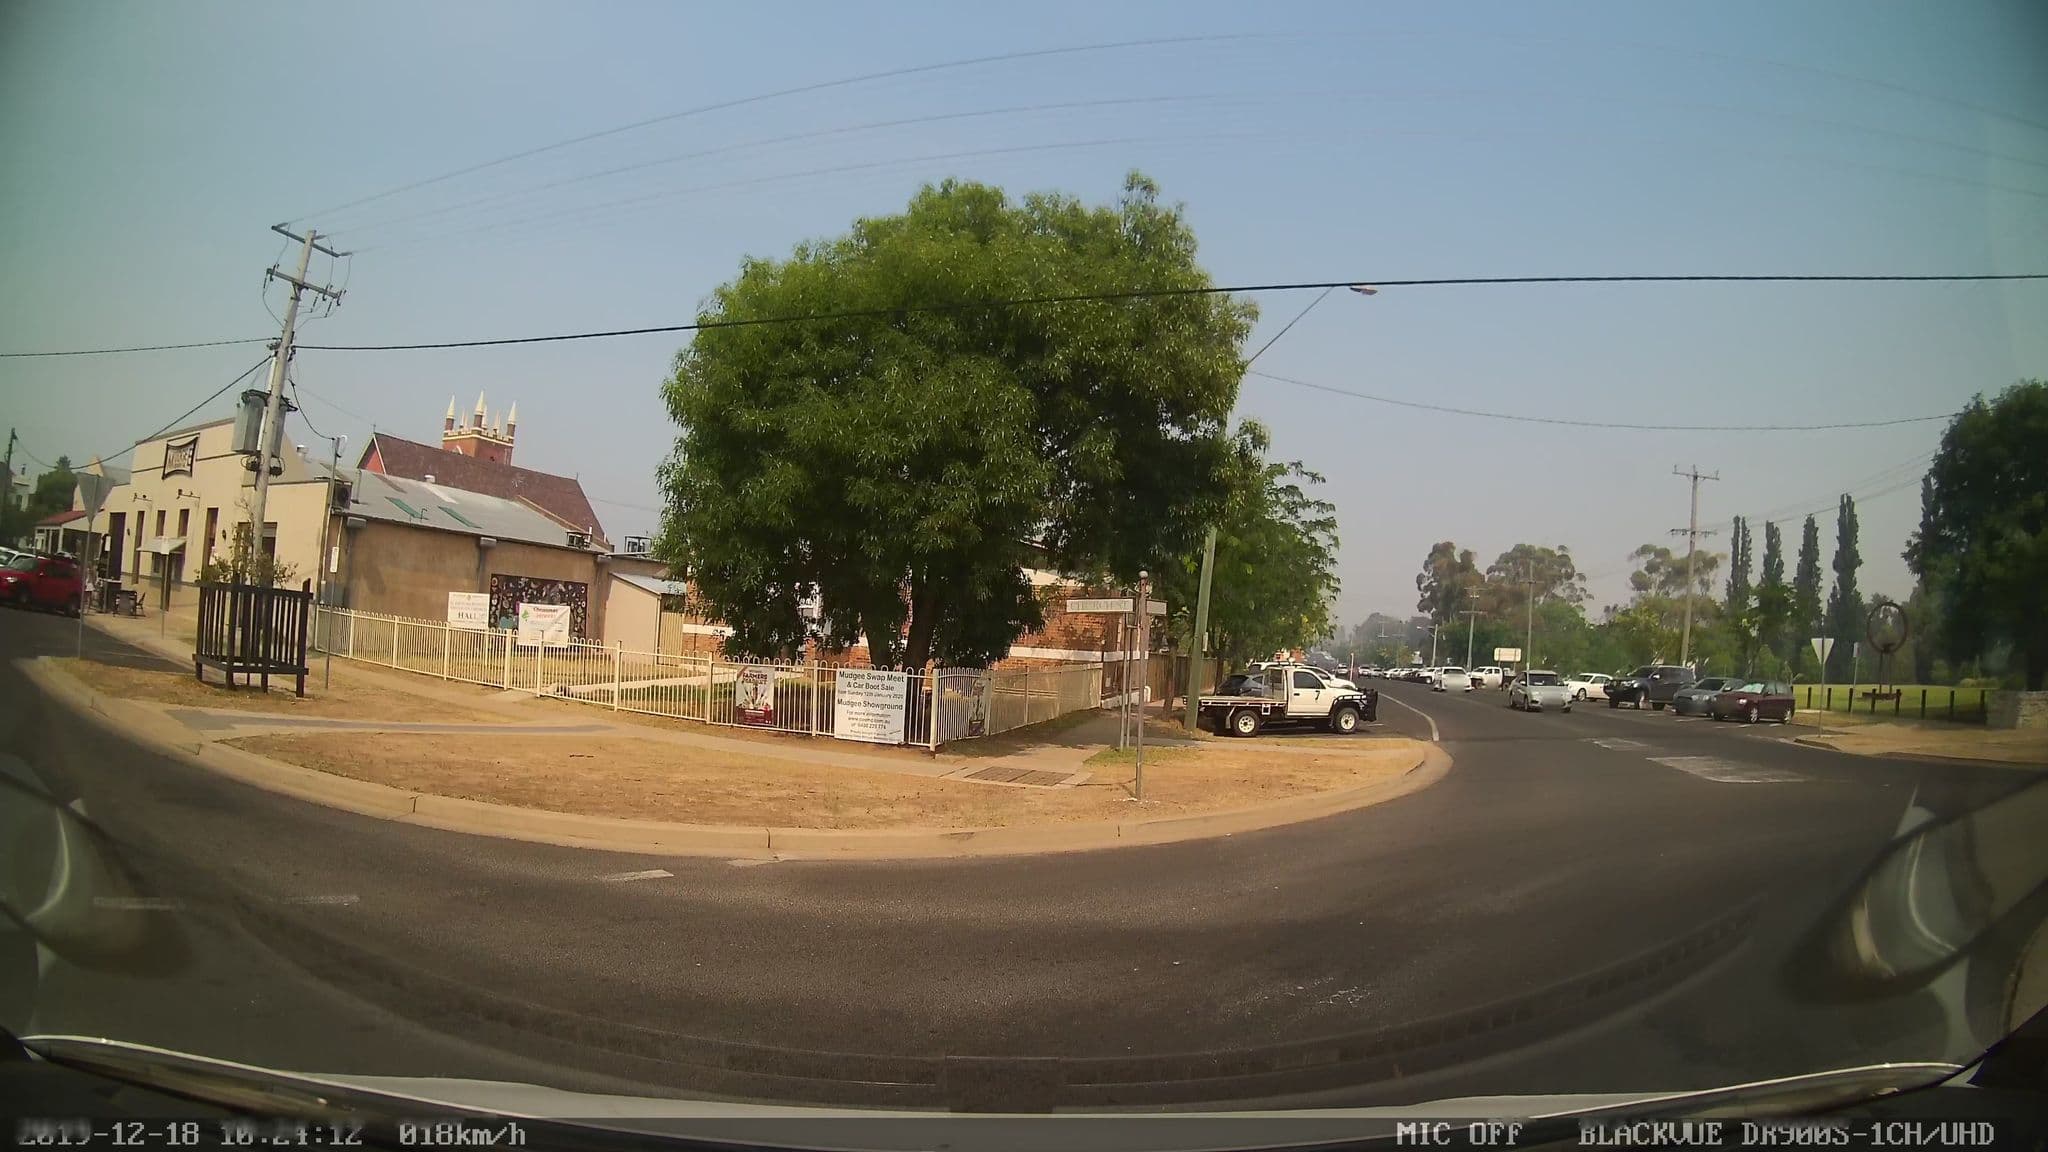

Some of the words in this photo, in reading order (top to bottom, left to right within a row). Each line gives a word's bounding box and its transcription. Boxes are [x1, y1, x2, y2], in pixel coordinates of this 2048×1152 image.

[743, 672, 768, 680] FARMERS
[839, 671, 866, 681] Mudgee
[866, 672, 886, 681] Swap
[886, 674, 905, 682] Meet
[837, 698, 862, 708] Mudgee
[862, 700, 903, 710] Showground
